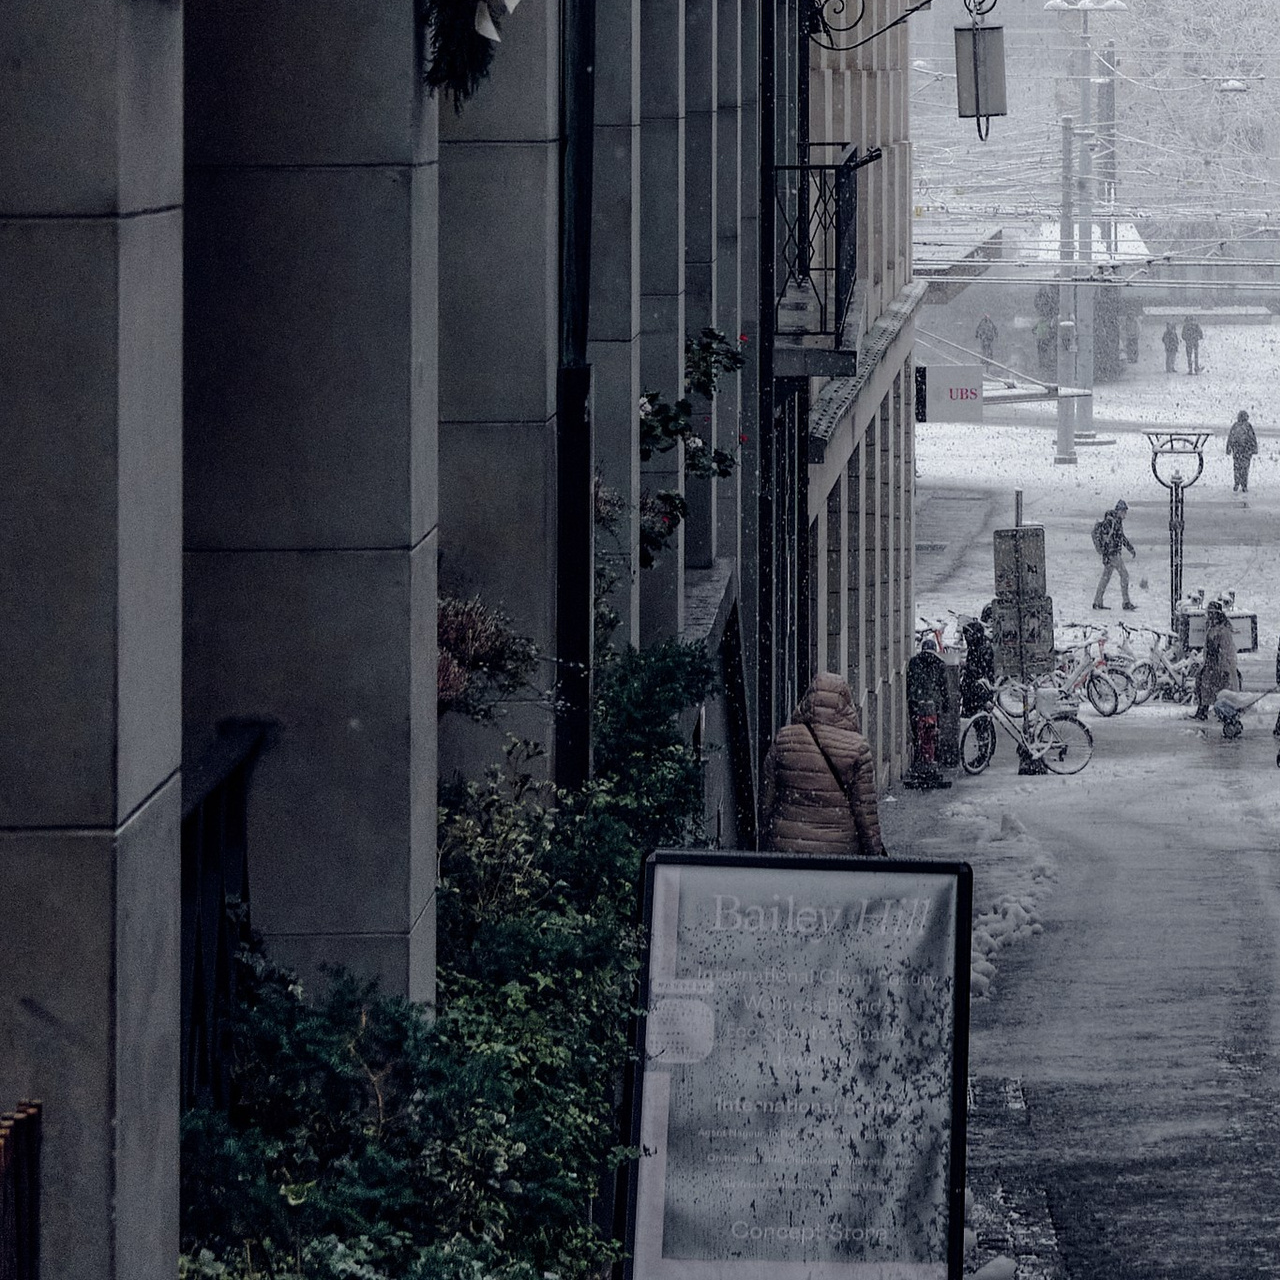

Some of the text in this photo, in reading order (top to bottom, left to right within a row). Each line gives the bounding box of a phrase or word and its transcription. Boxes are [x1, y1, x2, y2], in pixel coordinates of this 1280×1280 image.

[948, 387, 979, 401] UBS
[712, 893, 932, 943] Bailey Hill
[698, 966, 815, 984] International
[717, 1097, 838, 1115] International
[731, 1220, 888, 1245] Concept Store
